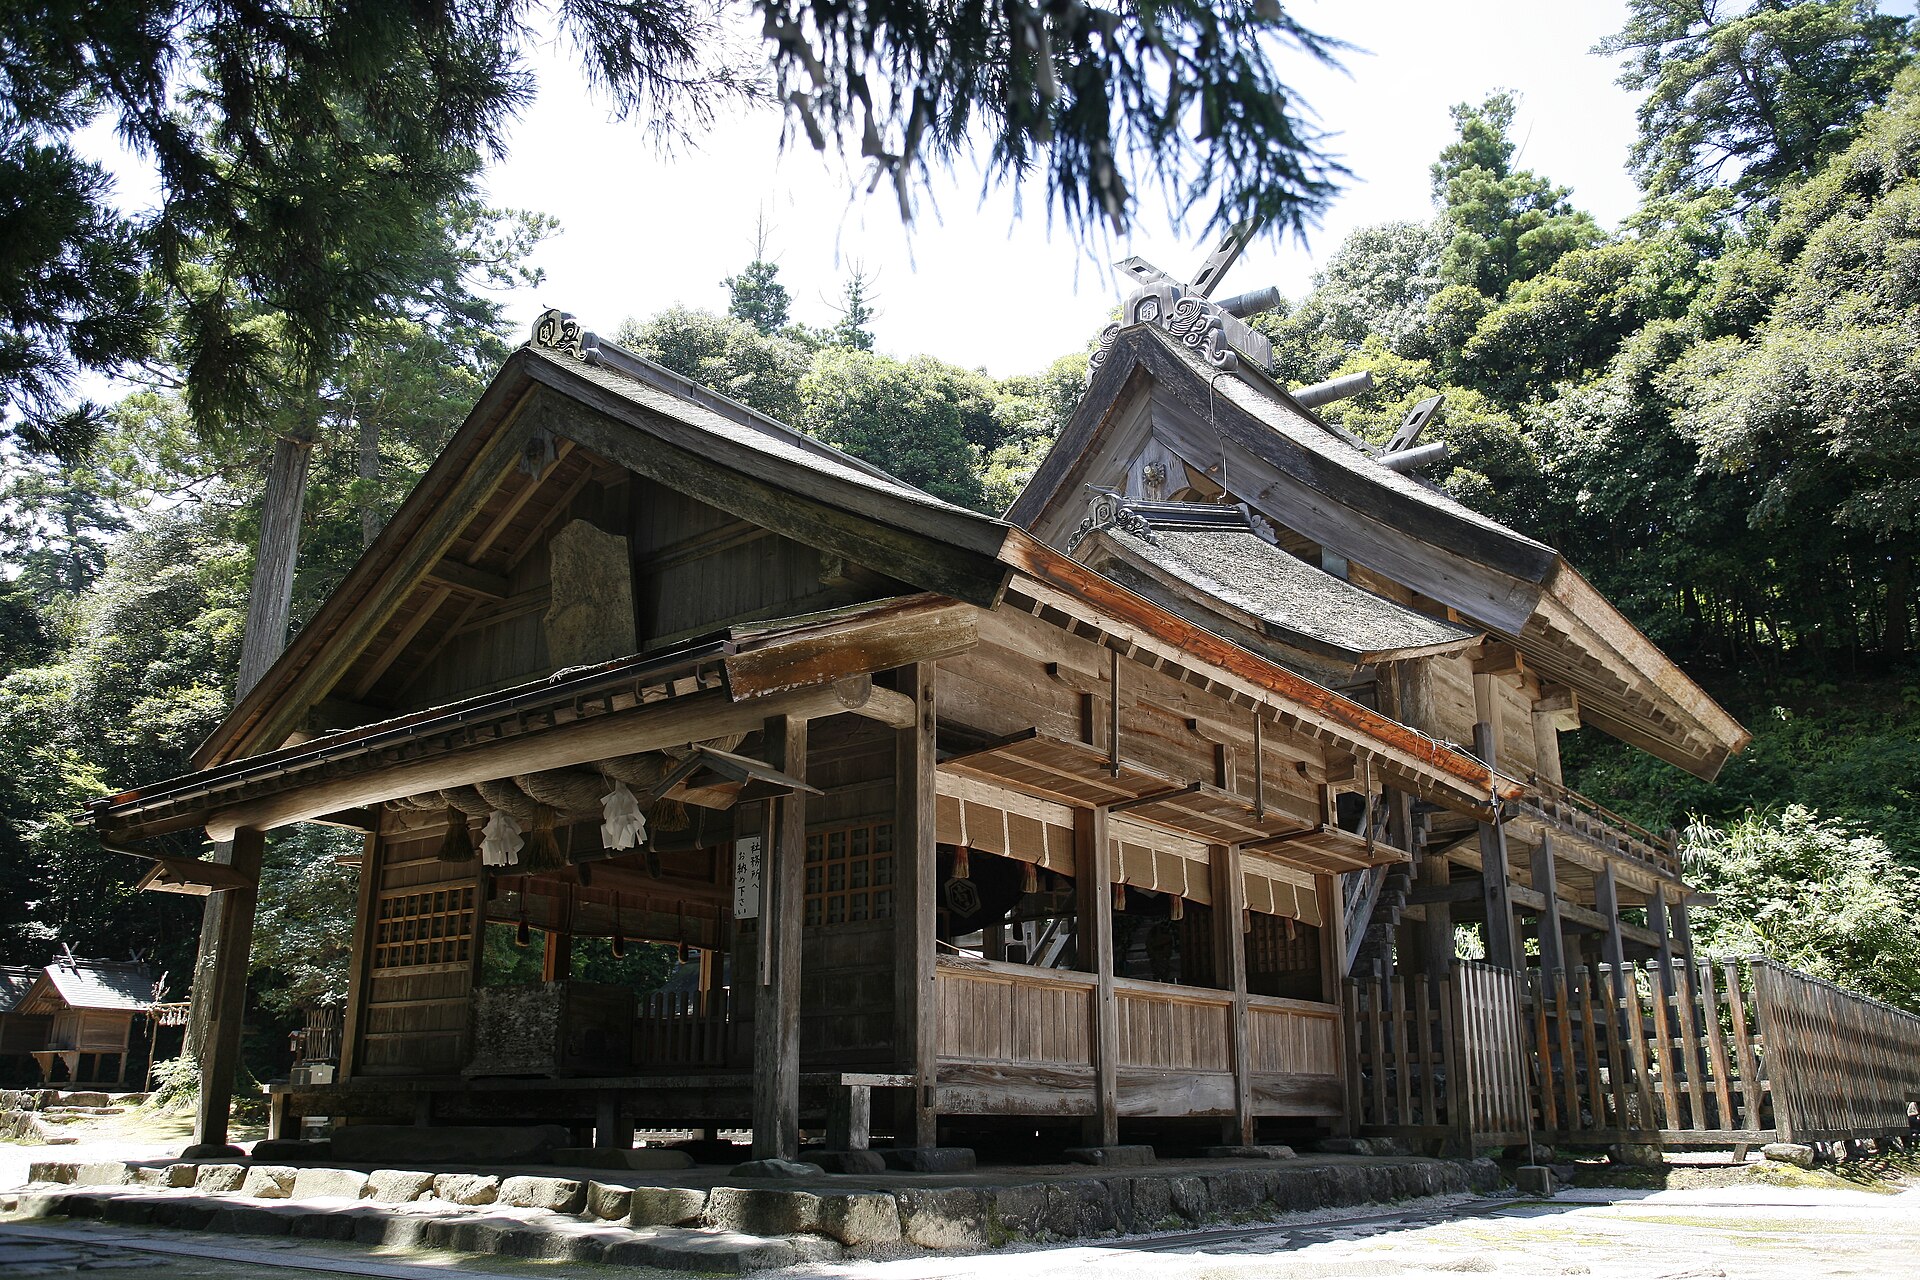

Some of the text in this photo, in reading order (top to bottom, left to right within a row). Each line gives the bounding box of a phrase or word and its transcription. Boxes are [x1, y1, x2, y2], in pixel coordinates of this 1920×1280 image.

[737, 851, 747, 915] お納め下さい
[750, 841, 760, 889] 社務所へ
